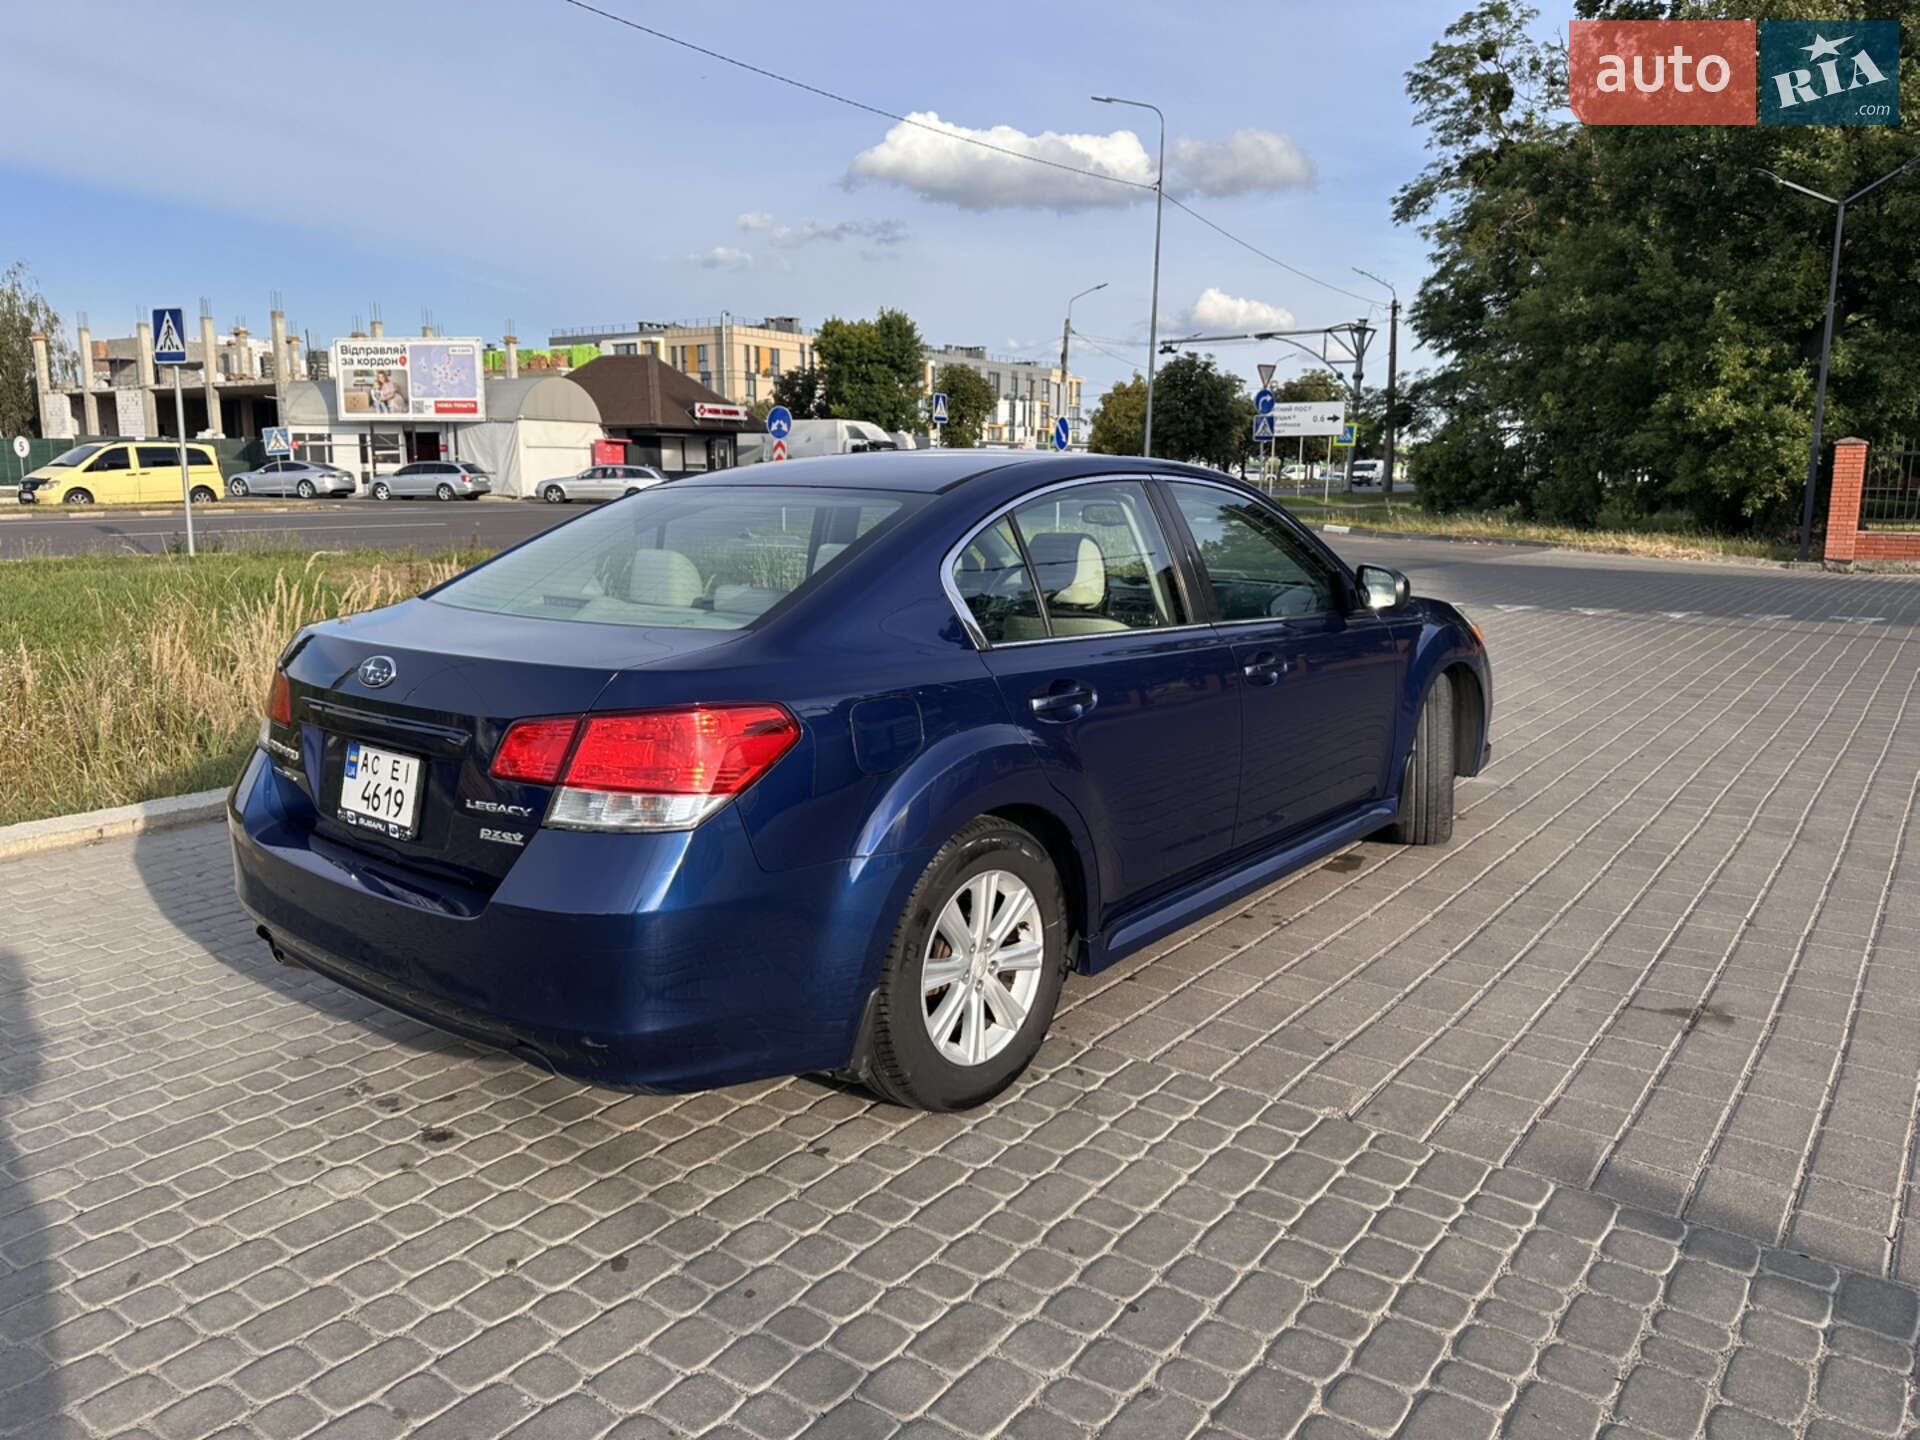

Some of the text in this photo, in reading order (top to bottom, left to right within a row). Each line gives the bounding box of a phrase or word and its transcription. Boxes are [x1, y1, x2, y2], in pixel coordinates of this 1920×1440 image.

[340, 344, 407, 356] Відправляй
[341, 357, 399, 367] за кордон
[18, 441, 25, 452] 5
[360, 752, 410, 785] AC EI
[360, 780, 405, 818] 4619
[465, 798, 533, 817] LEGACY
